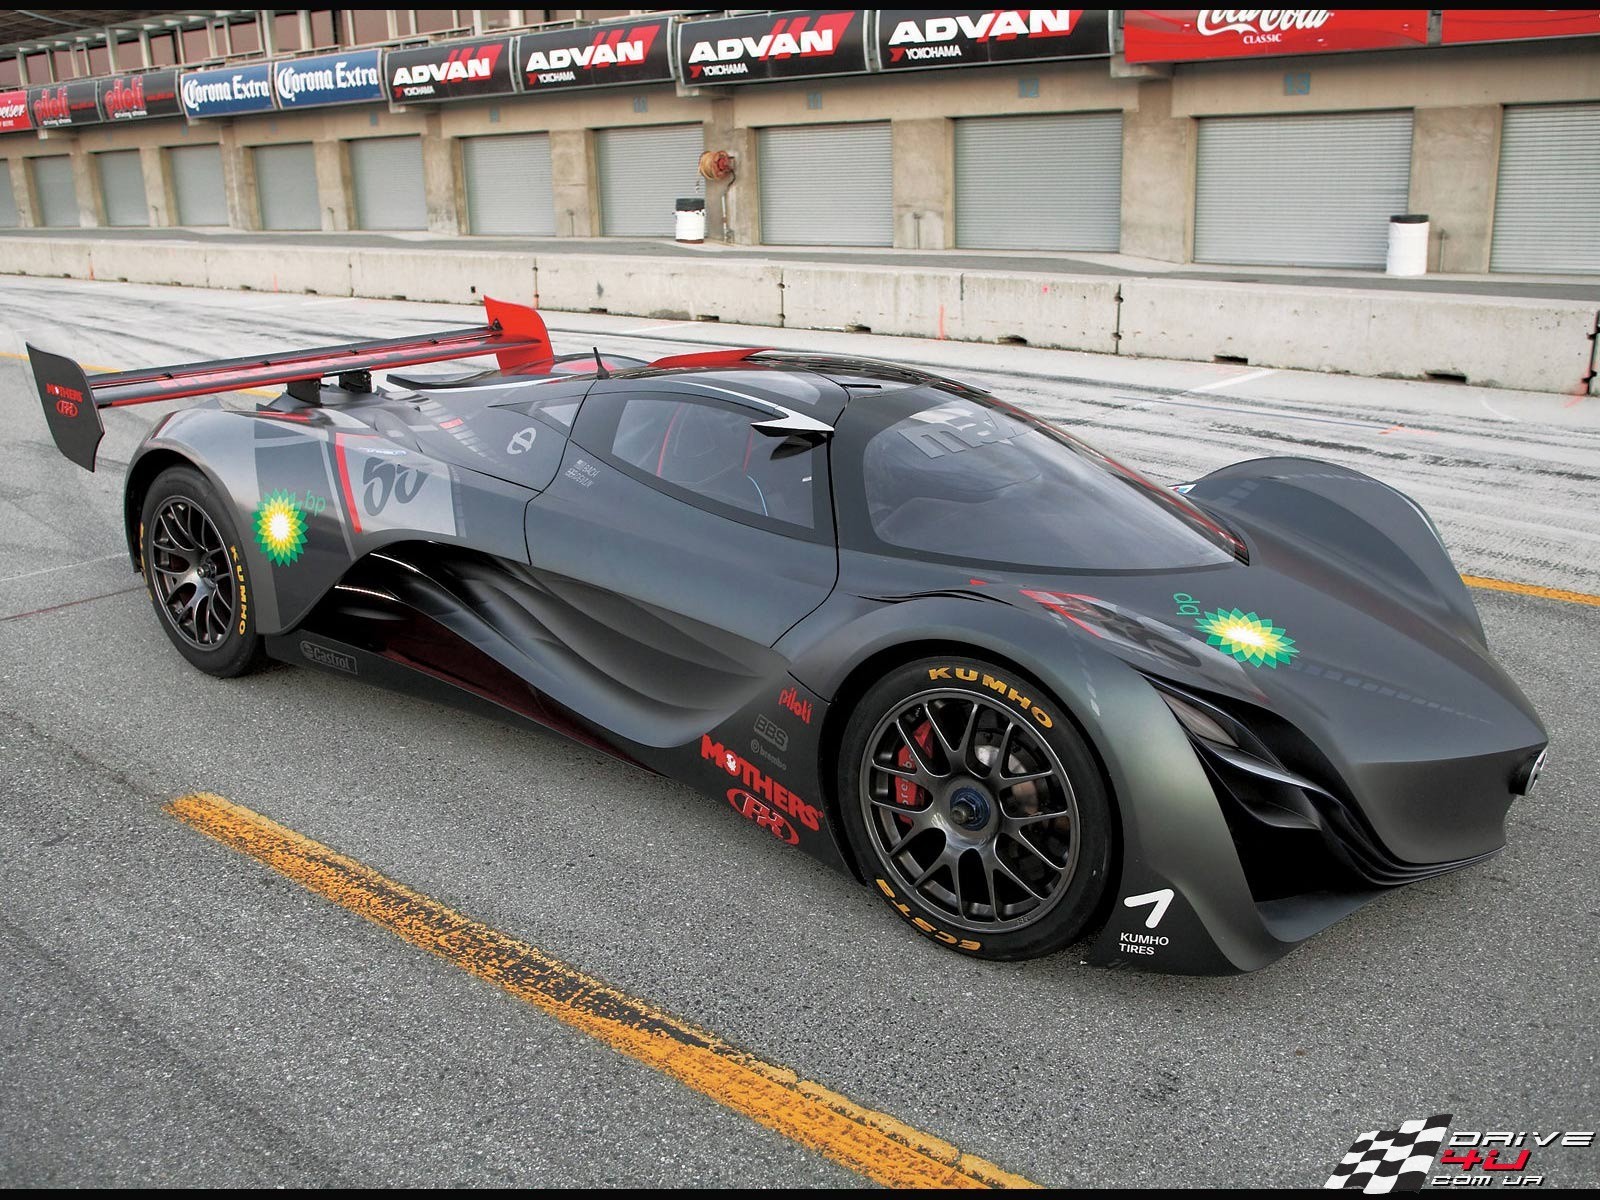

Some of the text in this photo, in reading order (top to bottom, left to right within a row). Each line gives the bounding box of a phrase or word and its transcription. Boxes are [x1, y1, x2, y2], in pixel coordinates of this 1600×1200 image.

[888, 10, 1071, 45] ADVAN
[1243, 33, 1282, 44] CLASSIC
[525, 40, 644, 72] ADVAN
[688, 30, 834, 64] ADVAN
[905, 45, 962, 60] YOKOHAMA
[278, 61, 378, 101] Corona Extra
[393, 58, 490, 86] ADVAN
[537, 71, 576, 84] YOKOHAMA
[702, 63, 748, 77] YOKOHAMA
[184, 75, 270, 112] Corona Extra
[1284, 72, 1310, 96] 13
[0, 99, 25, 118] eiser
[304, 490, 327, 517] bp
[230, 545, 247, 635] KUMHO
[1173, 592, 1200, 616] bp
[313, 647, 350, 670] Castrol
[928, 667, 1053, 729] KUMHO
[754, 714, 788, 751] BBS
[702, 734, 821, 832] MOTHERS
[1119, 932, 1169, 947] KUMHO
[1119, 943, 1155, 956] TIRES
